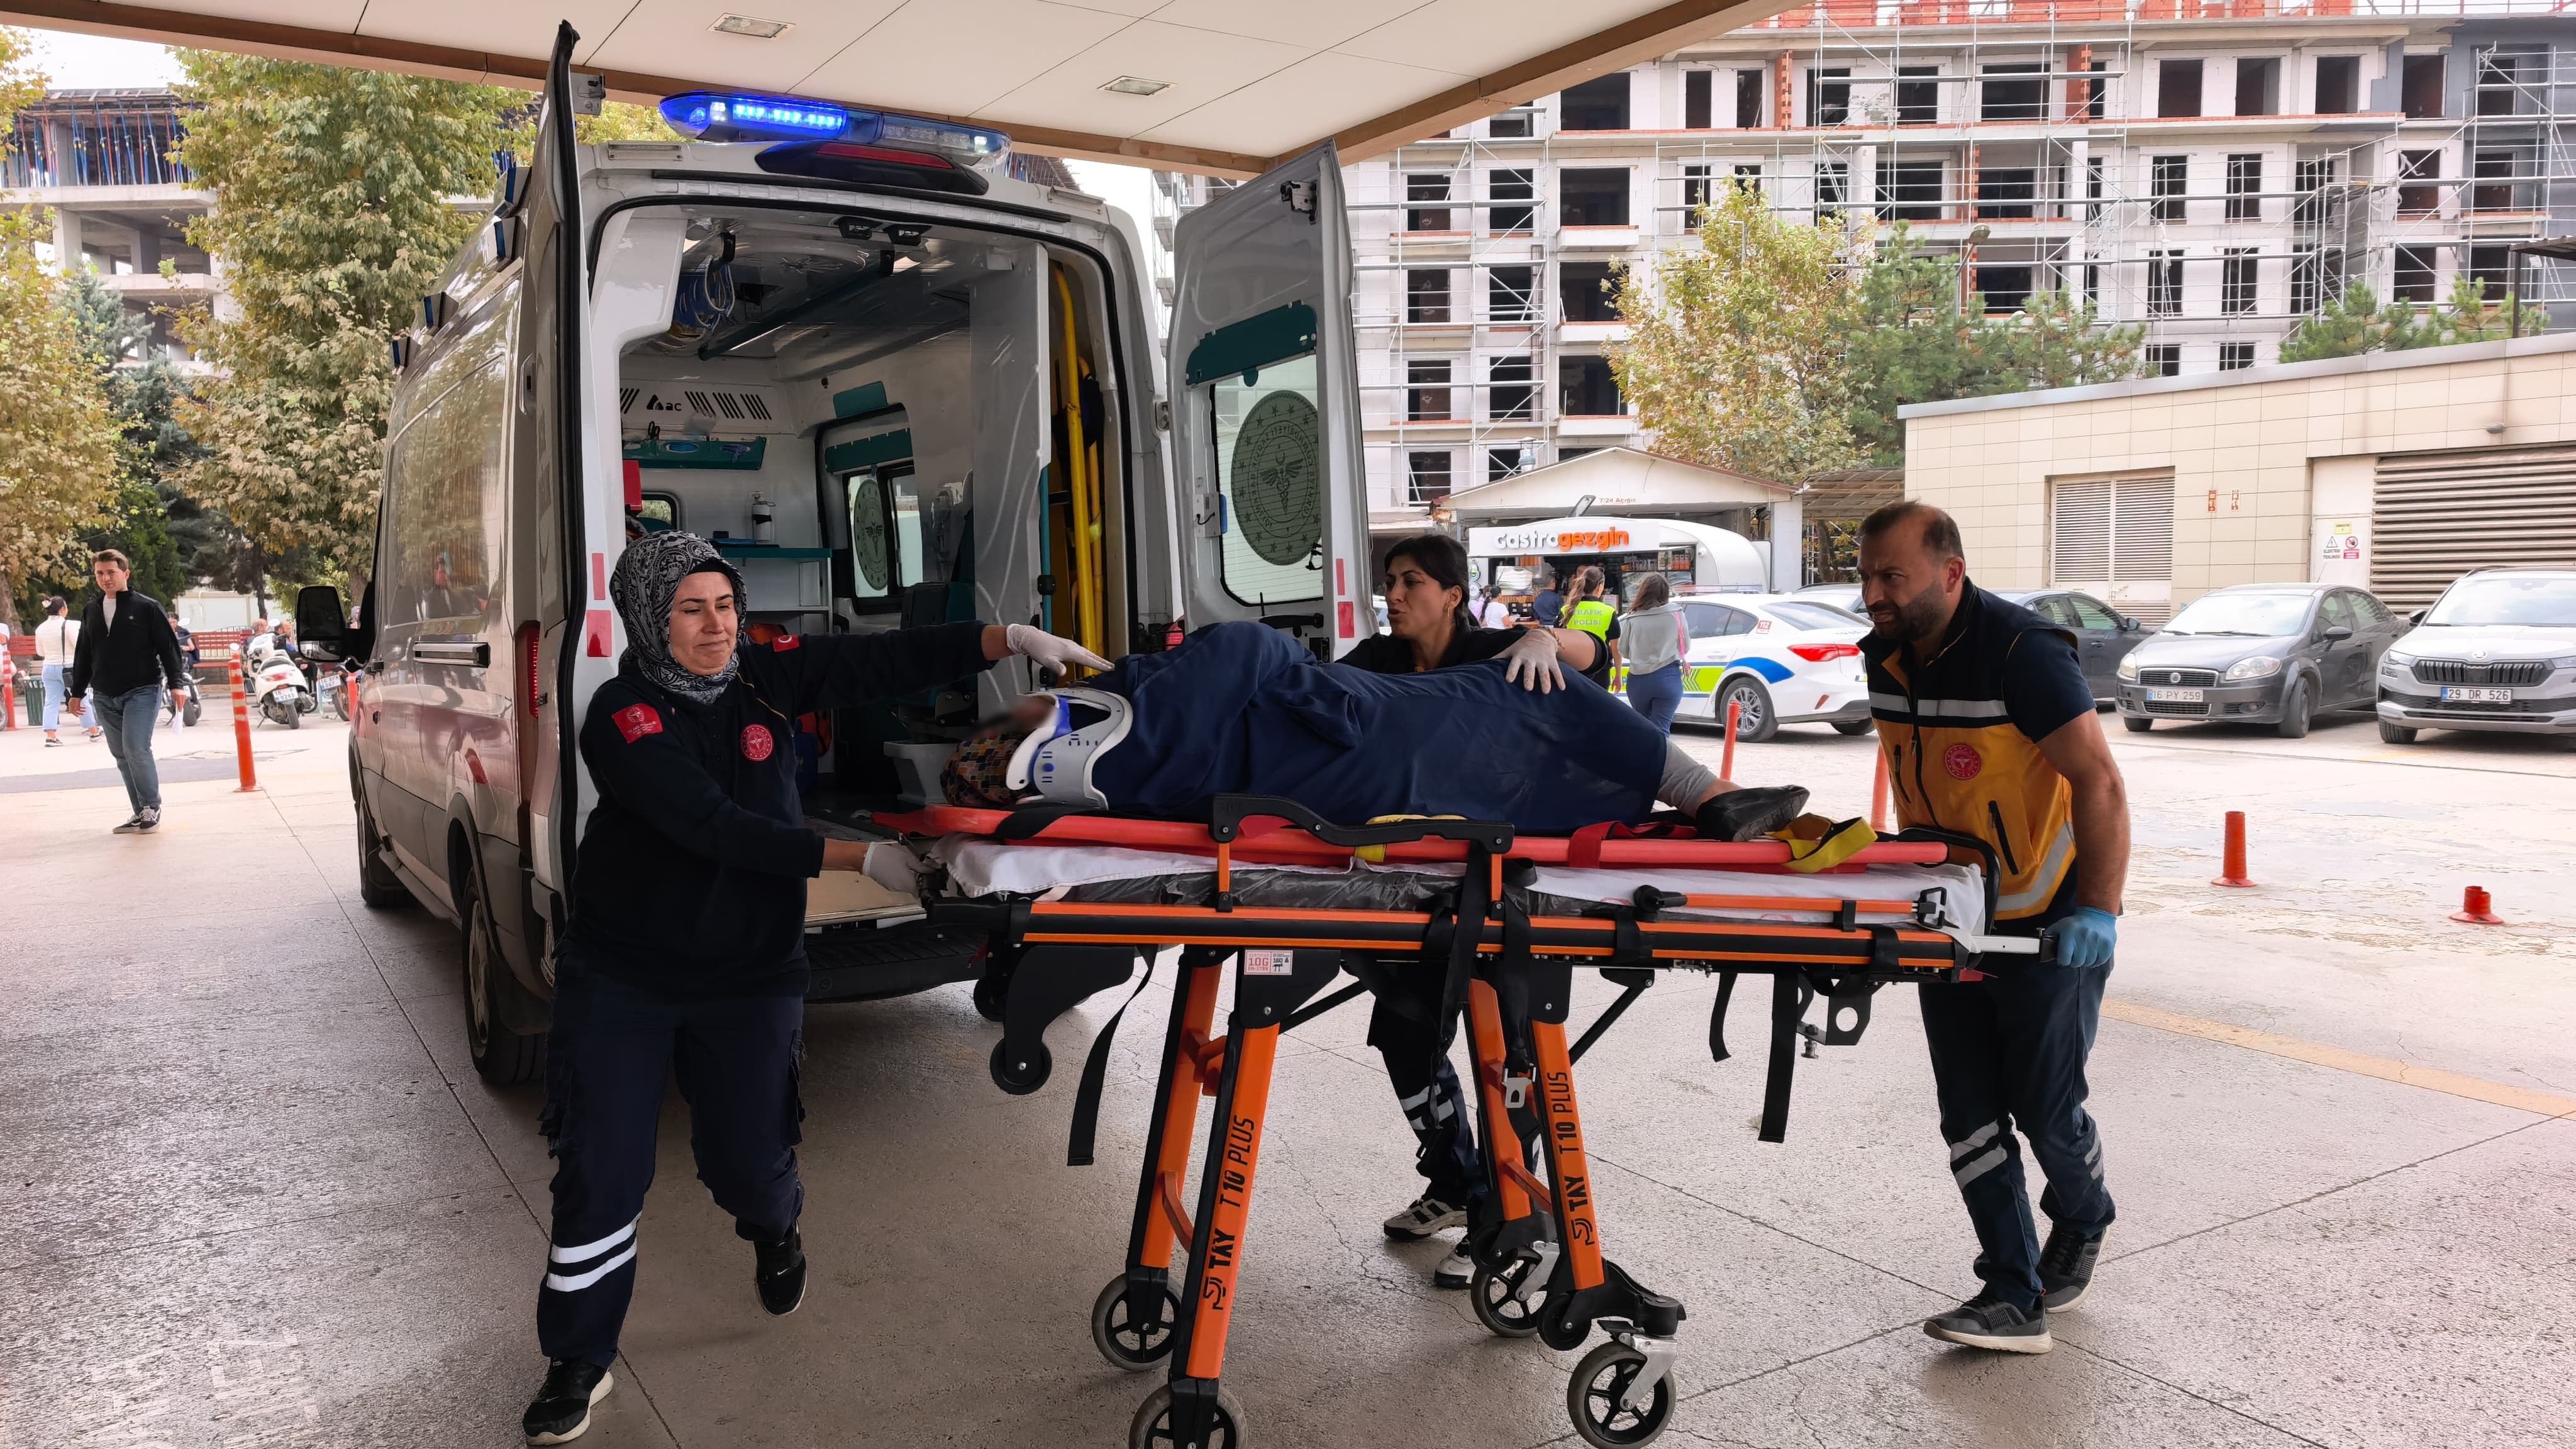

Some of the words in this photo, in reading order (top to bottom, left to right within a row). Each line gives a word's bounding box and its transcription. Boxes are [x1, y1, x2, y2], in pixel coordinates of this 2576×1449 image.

[2153, 691, 2162, 699] 16
[2167, 691, 2179, 699] PY
[2448, 689, 2461, 699] 29
[2468, 689, 2481, 699] DR
[2489, 691, 2509, 700] 526
[1547, 1072, 1573, 1113] PLUS
[1208, 1227, 1235, 1269] TAY
[1228, 1114, 1255, 1166] PLUS
[1564, 1175, 1588, 1212] TAY
